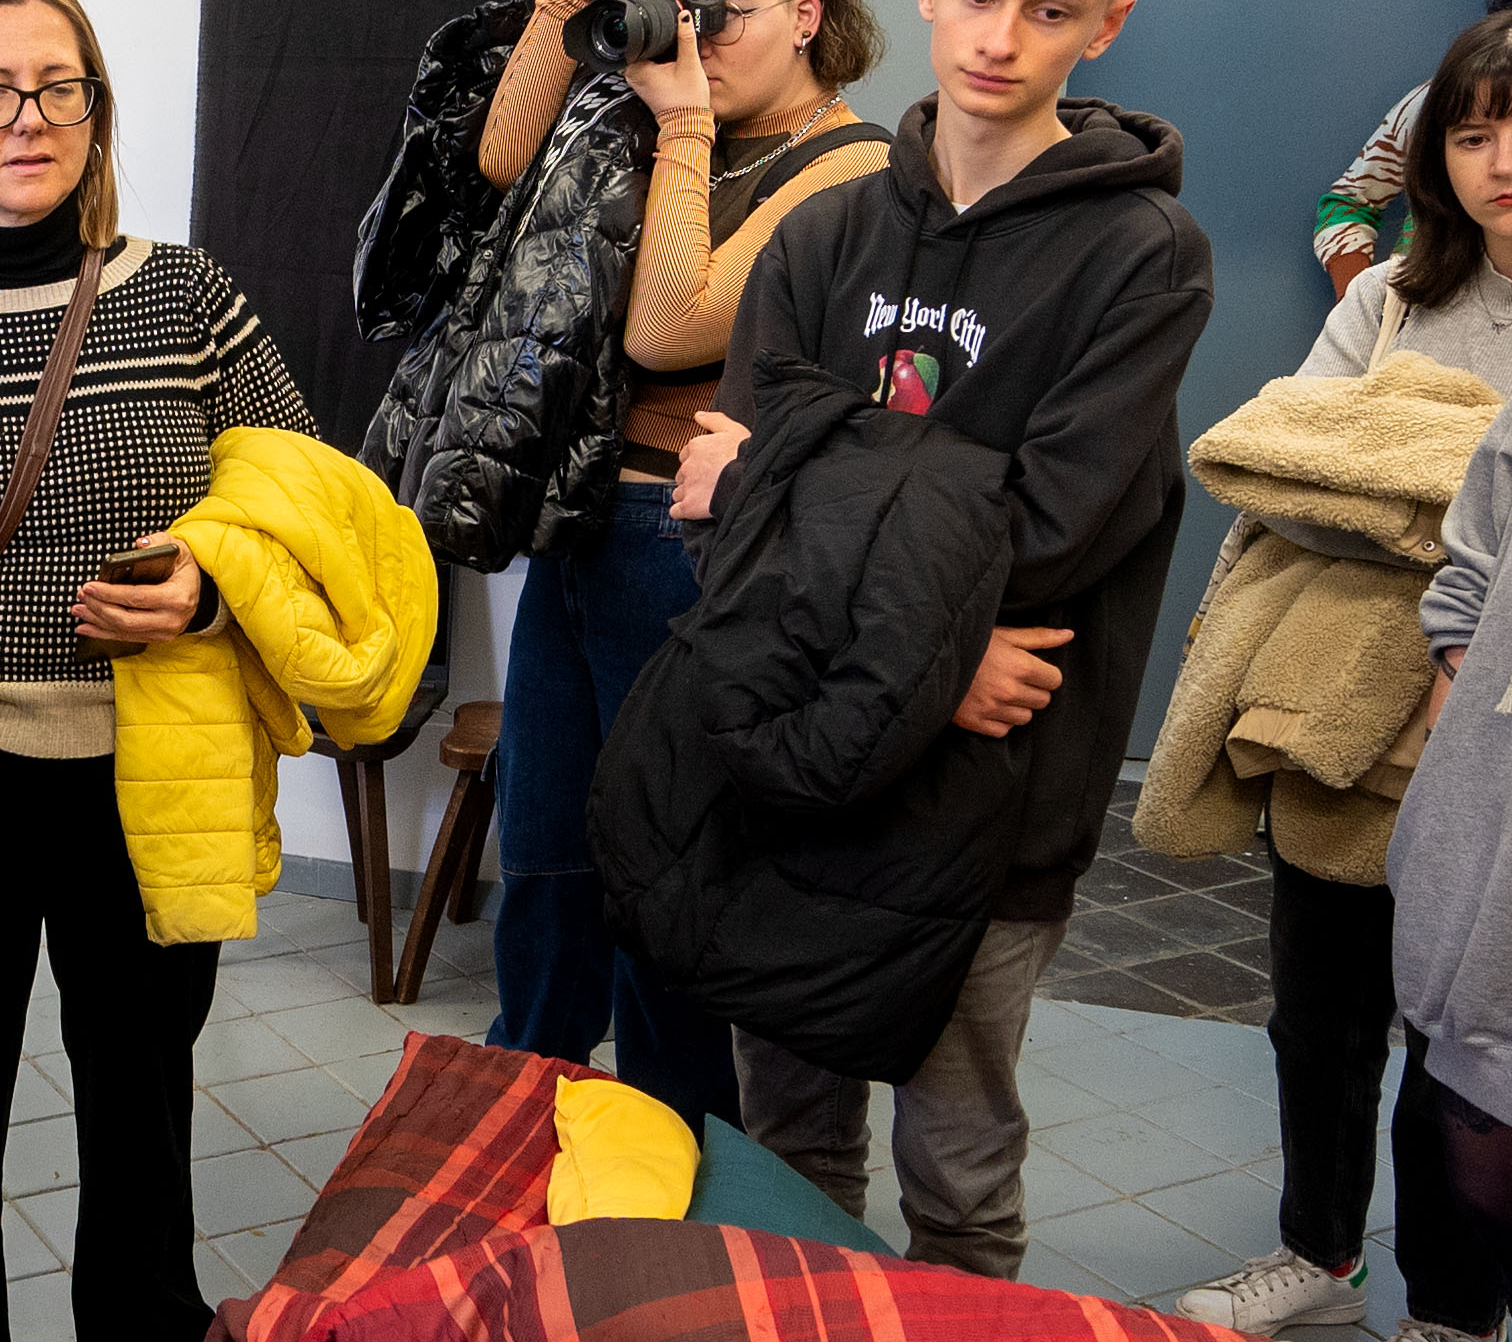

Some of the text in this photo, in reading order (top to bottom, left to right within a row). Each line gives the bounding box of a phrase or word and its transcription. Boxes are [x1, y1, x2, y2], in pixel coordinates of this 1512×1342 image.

[694, 8, 702, 34] SONY
[863, 290, 899, 338] New
[950, 307, 987, 369] City
